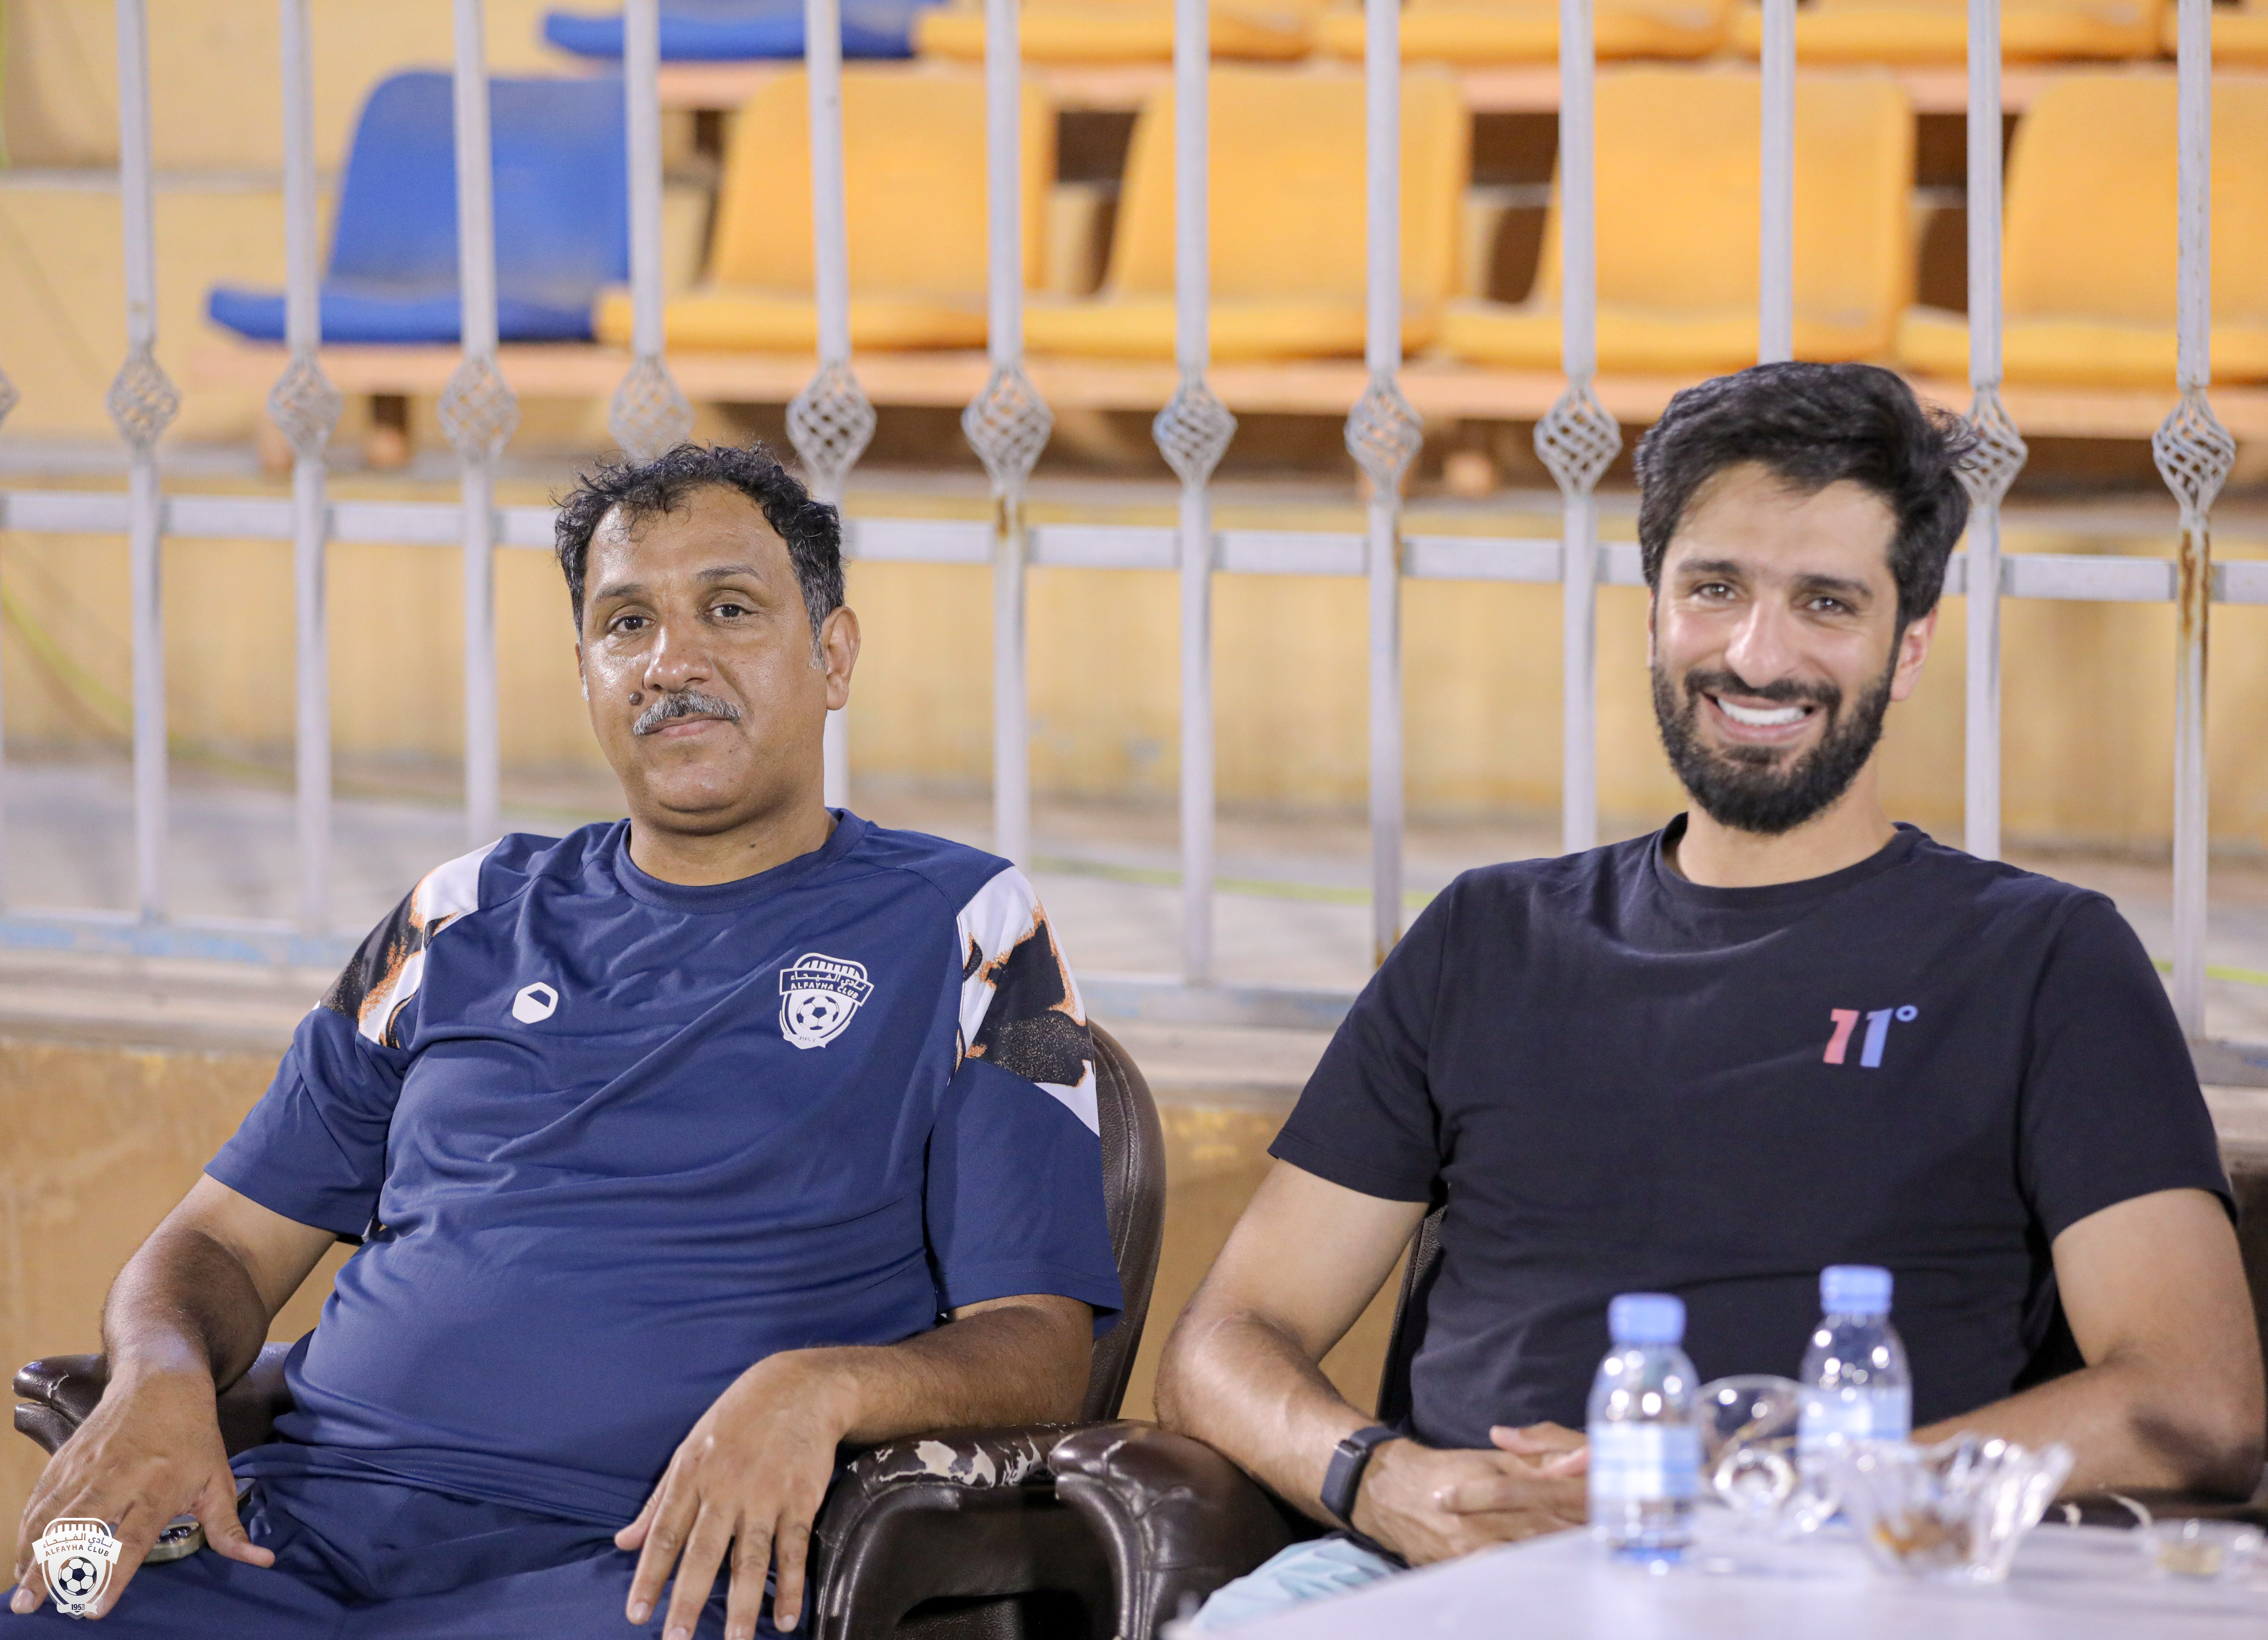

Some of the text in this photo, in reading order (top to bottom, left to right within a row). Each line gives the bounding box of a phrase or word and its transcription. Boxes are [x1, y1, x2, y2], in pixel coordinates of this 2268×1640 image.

[790, 971, 867, 992] نادي الفيحاء
[791, 981, 859, 999] ALFAYHA CLUB
